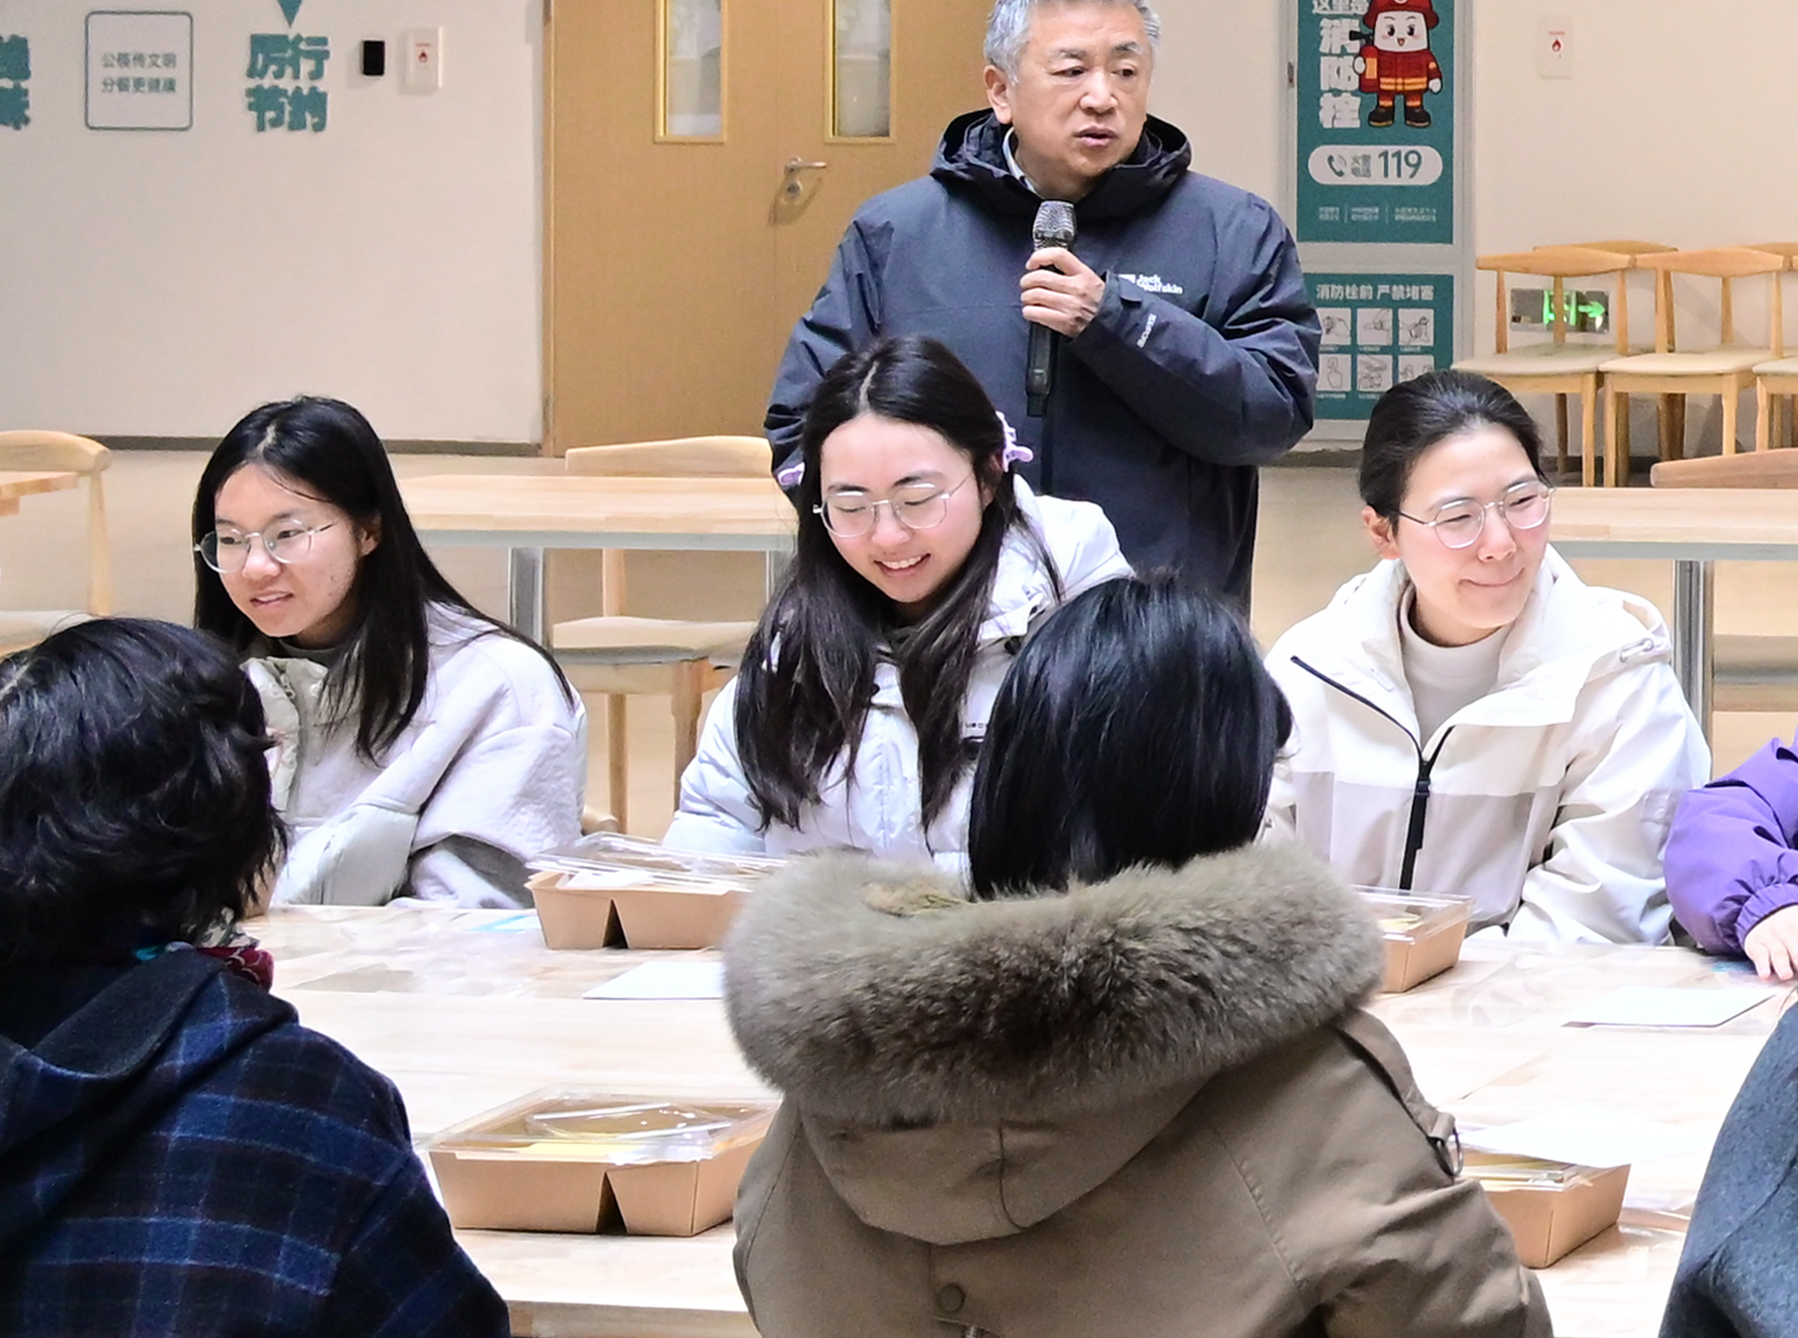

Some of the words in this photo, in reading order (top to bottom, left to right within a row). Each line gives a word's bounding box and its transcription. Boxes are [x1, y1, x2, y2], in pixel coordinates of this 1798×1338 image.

[246, 85, 328, 132] 节约
[1378, 150, 1422, 179] 119
[1316, 284, 1373, 300] 消防栓前
